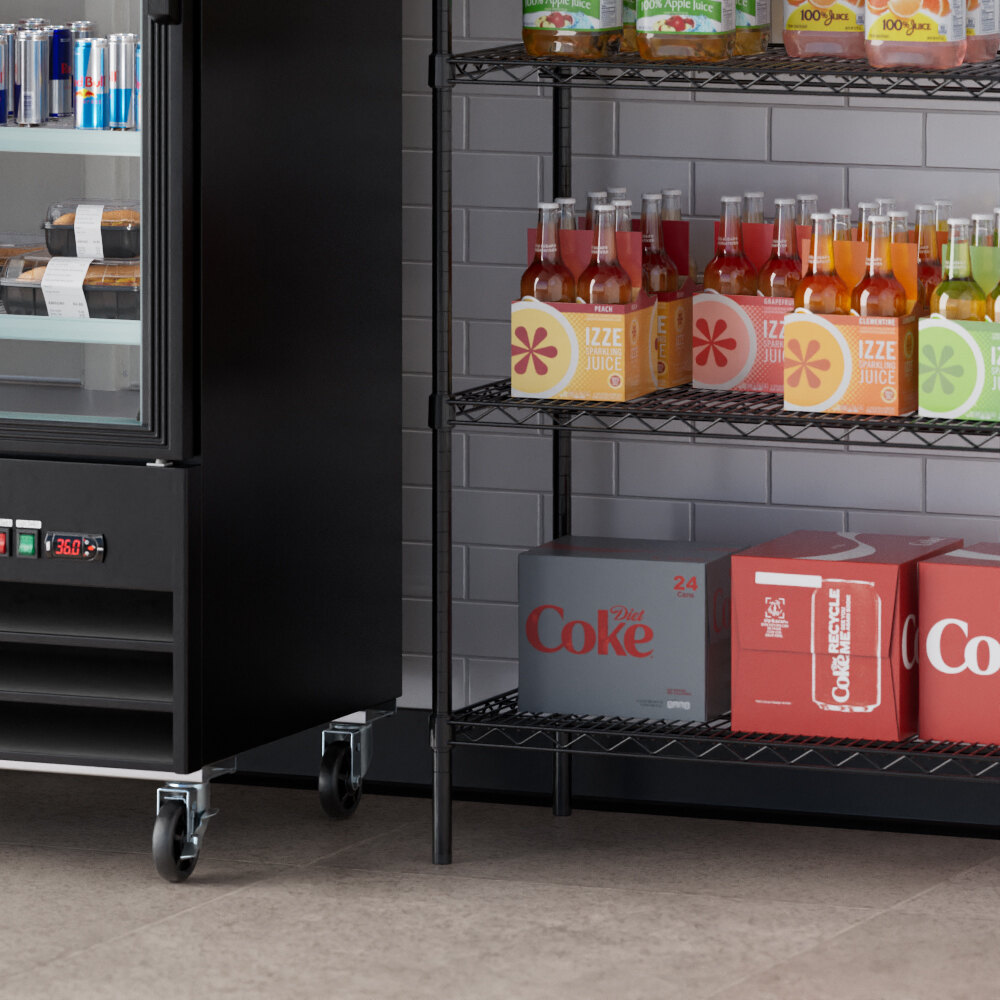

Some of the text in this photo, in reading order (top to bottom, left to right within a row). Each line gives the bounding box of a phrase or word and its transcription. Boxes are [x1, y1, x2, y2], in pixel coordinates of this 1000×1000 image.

[641, 0, 662, 11] 100%
[693, 1, 714, 12] Juice
[800, 9, 828, 21] 100%
[883, 19, 909, 31] 100%
[594, 305, 613, 313] PEACH
[858, 318, 895, 326] CLEMENTINE
[585, 326, 622, 347] IZZE
[585, 348, 622, 356] SPARKLING
[763, 349, 784, 363] JUI
[858, 339, 896, 360] IZZE
[585, 356, 622, 371] JUICE
[858, 360, 896, 369] SPARKLING
[859, 369, 896, 385] JUICE
[673, 575, 698, 591] 24
[610, 605, 645, 621] Diet
[525, 604, 655, 658] Coke
[828, 588, 850, 703] Coke RECYCLE
[840, 630, 850, 654] ME
[926, 617, 1000, 676] Co
